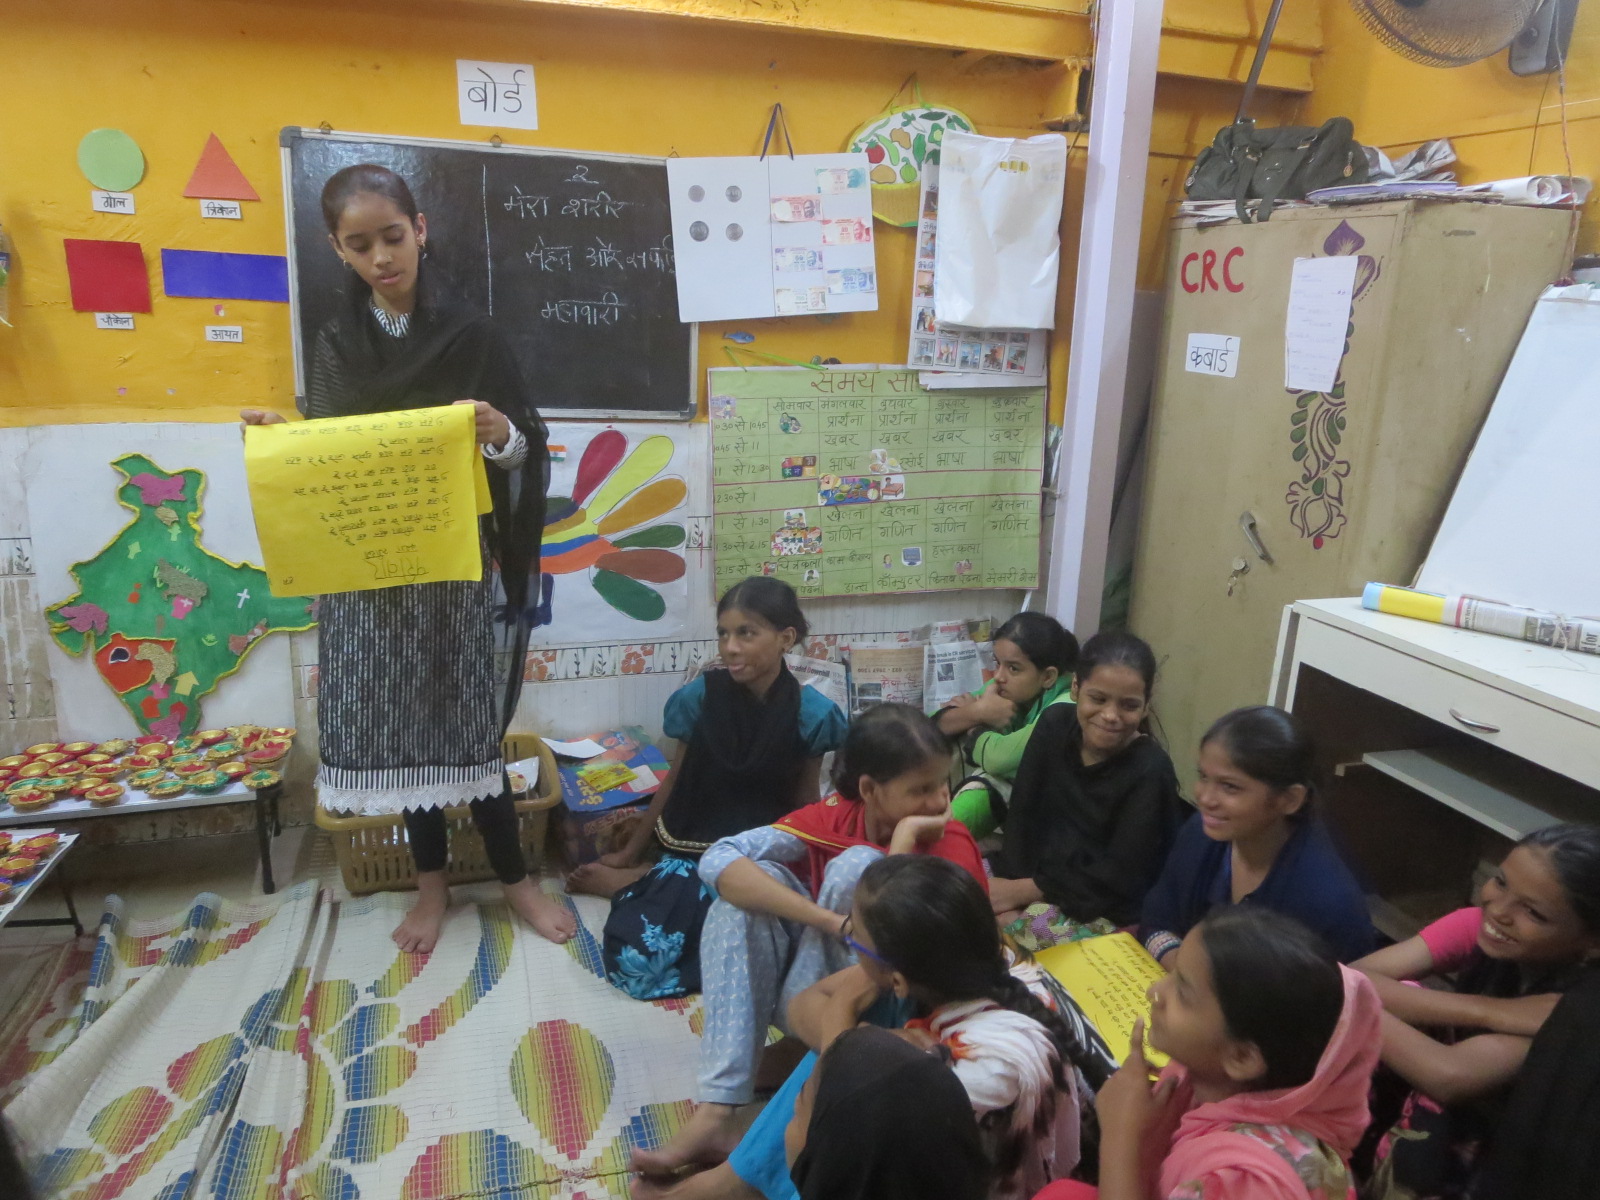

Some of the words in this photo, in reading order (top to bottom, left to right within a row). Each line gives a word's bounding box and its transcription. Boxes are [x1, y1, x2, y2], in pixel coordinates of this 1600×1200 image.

[463, 67, 527, 113] बोर्ड
[101, 193, 128, 209] गोल
[504, 185, 550, 219] मेरा
[1180, 246, 1245, 293] CRC
[211, 329, 240, 341] आयत
[811, 372, 880, 393] समय
[773, 398, 815, 411] सोमवार
